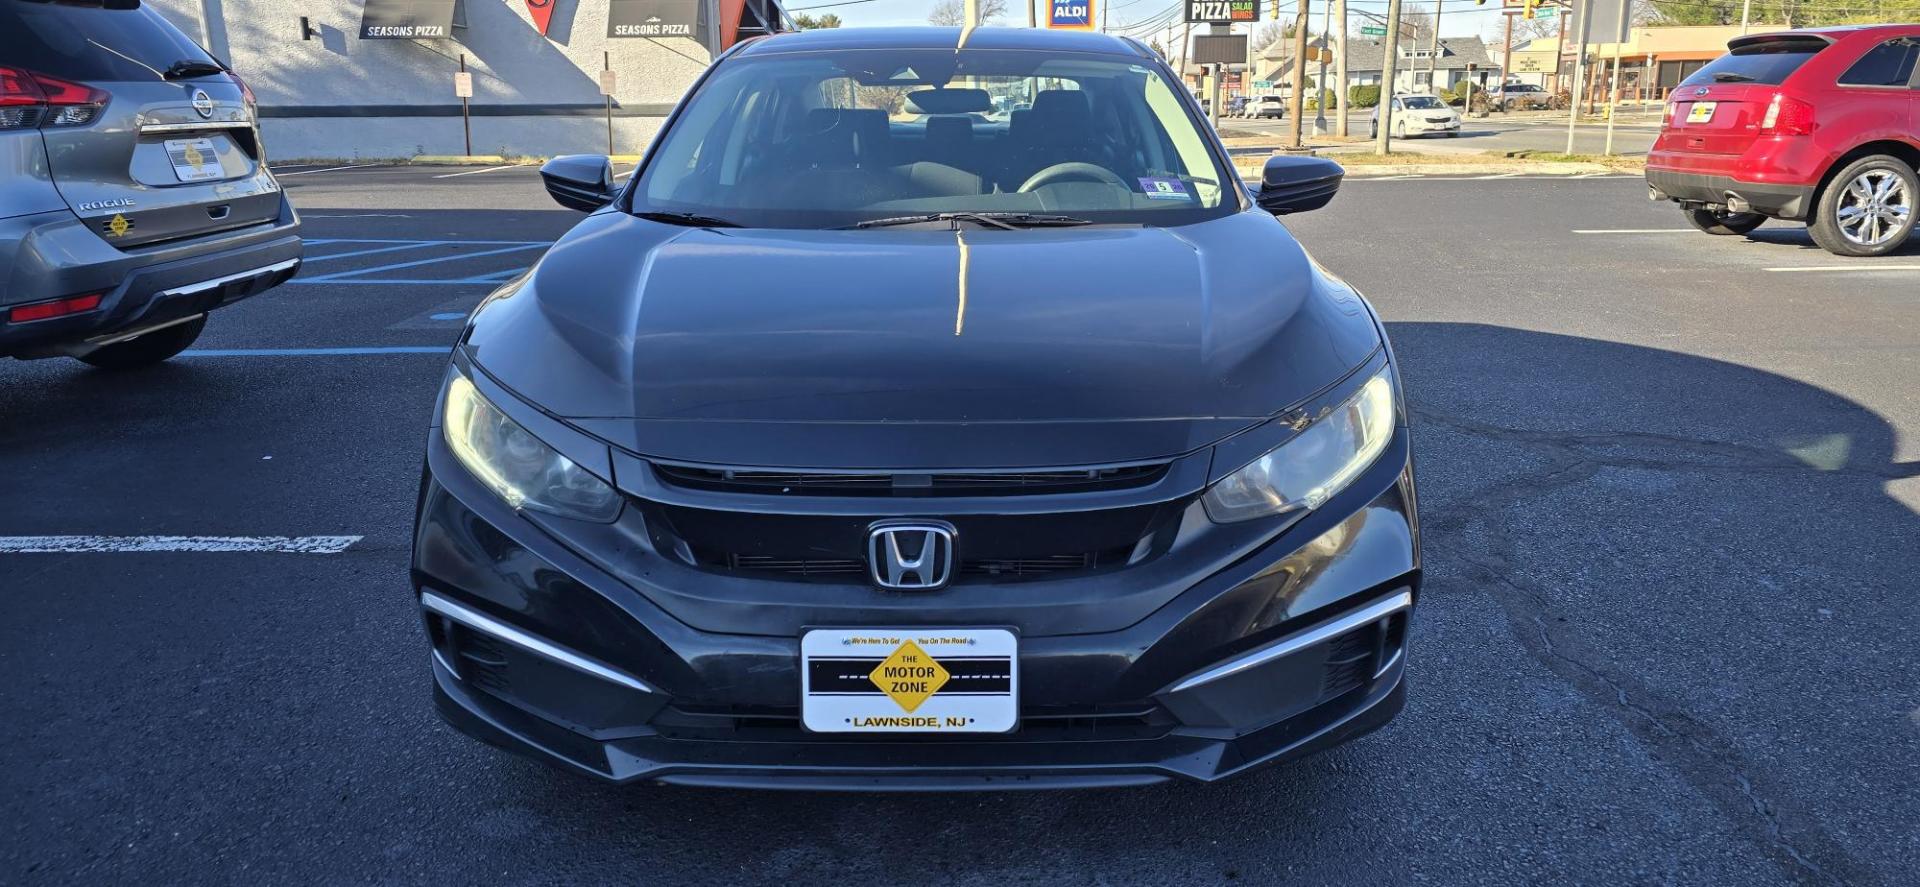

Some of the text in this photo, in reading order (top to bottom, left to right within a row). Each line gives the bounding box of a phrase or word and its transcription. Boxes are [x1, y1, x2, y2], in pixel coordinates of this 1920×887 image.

[1054, 6, 1087, 17] ALDI
[1192, 2, 1231, 19] PIZZA
[1232, 2, 1253, 10] SALAD
[1231, 10, 1253, 19] WINGS
[367, 25, 443, 37] SEASONS PIZZA
[615, 24, 690, 35] SEASONS PIZZA
[1158, 182, 1169, 191] 5
[78, 197, 137, 211] ROGUE
[890, 637, 900, 645] Get
[918, 637, 929, 645] You
[902, 655, 917, 663] THE
[884, 666, 935, 678] MOTOR
[891, 682, 928, 693] ZONE
[853, 717, 966, 728] LAWNSIDE, NJ
